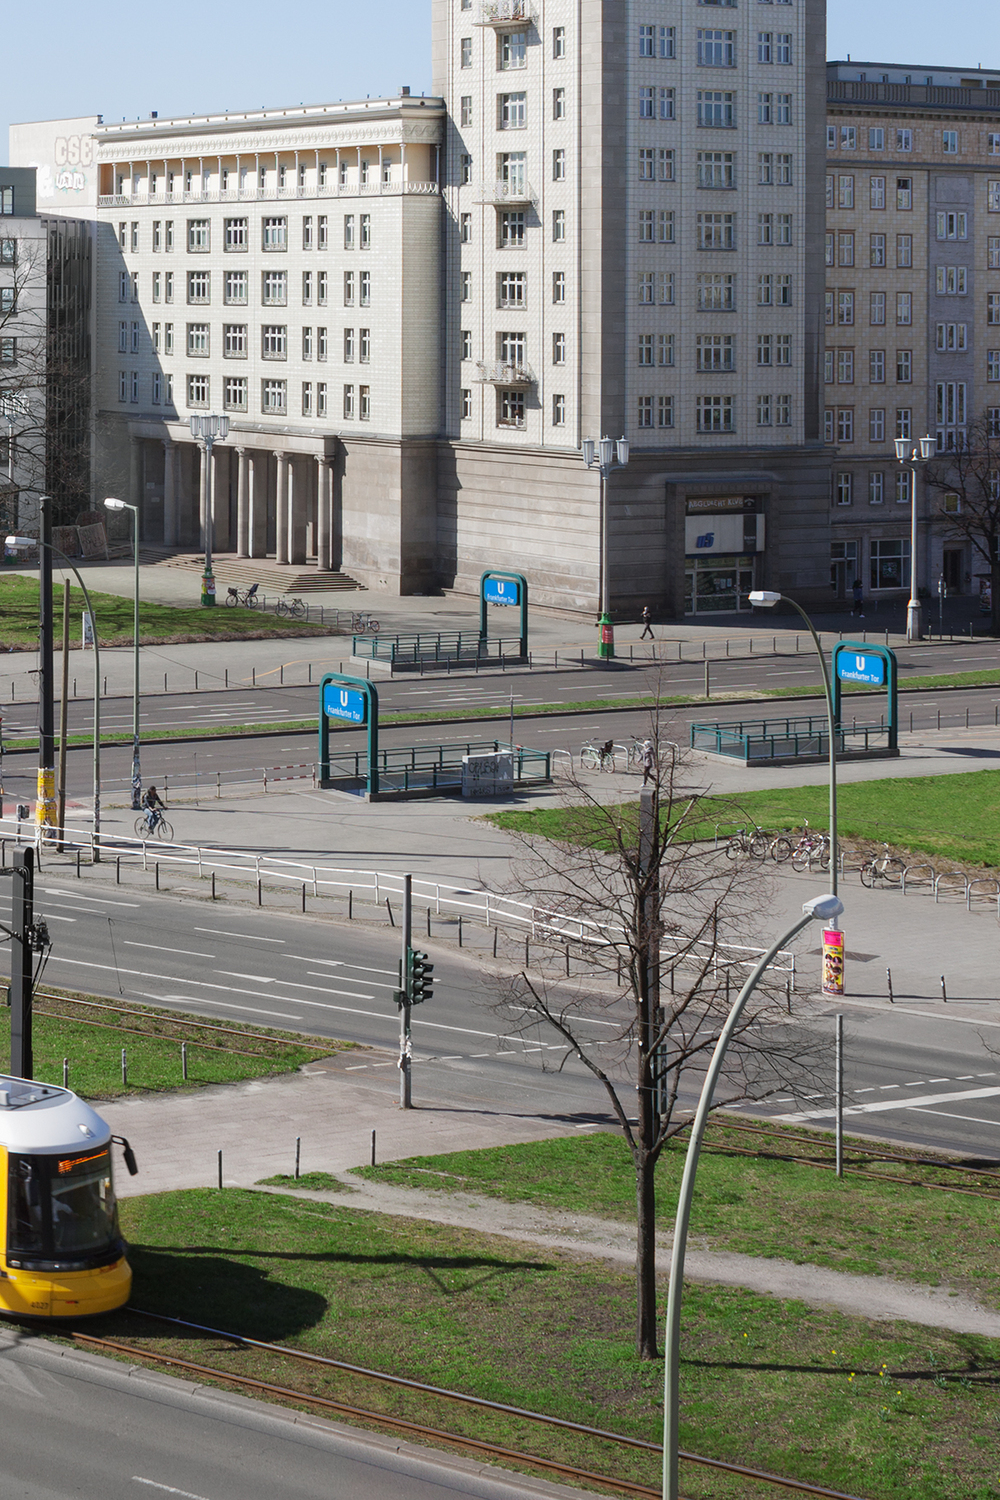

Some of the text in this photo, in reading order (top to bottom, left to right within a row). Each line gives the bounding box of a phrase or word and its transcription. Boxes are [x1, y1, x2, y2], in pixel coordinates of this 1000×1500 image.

[497, 582, 505, 595] U
[856, 656, 865, 671] U
[842, 670, 879, 682] Frankfurter Tor
[340, 690, 348, 707] U
[328, 705, 352, 718] Frankfurter
